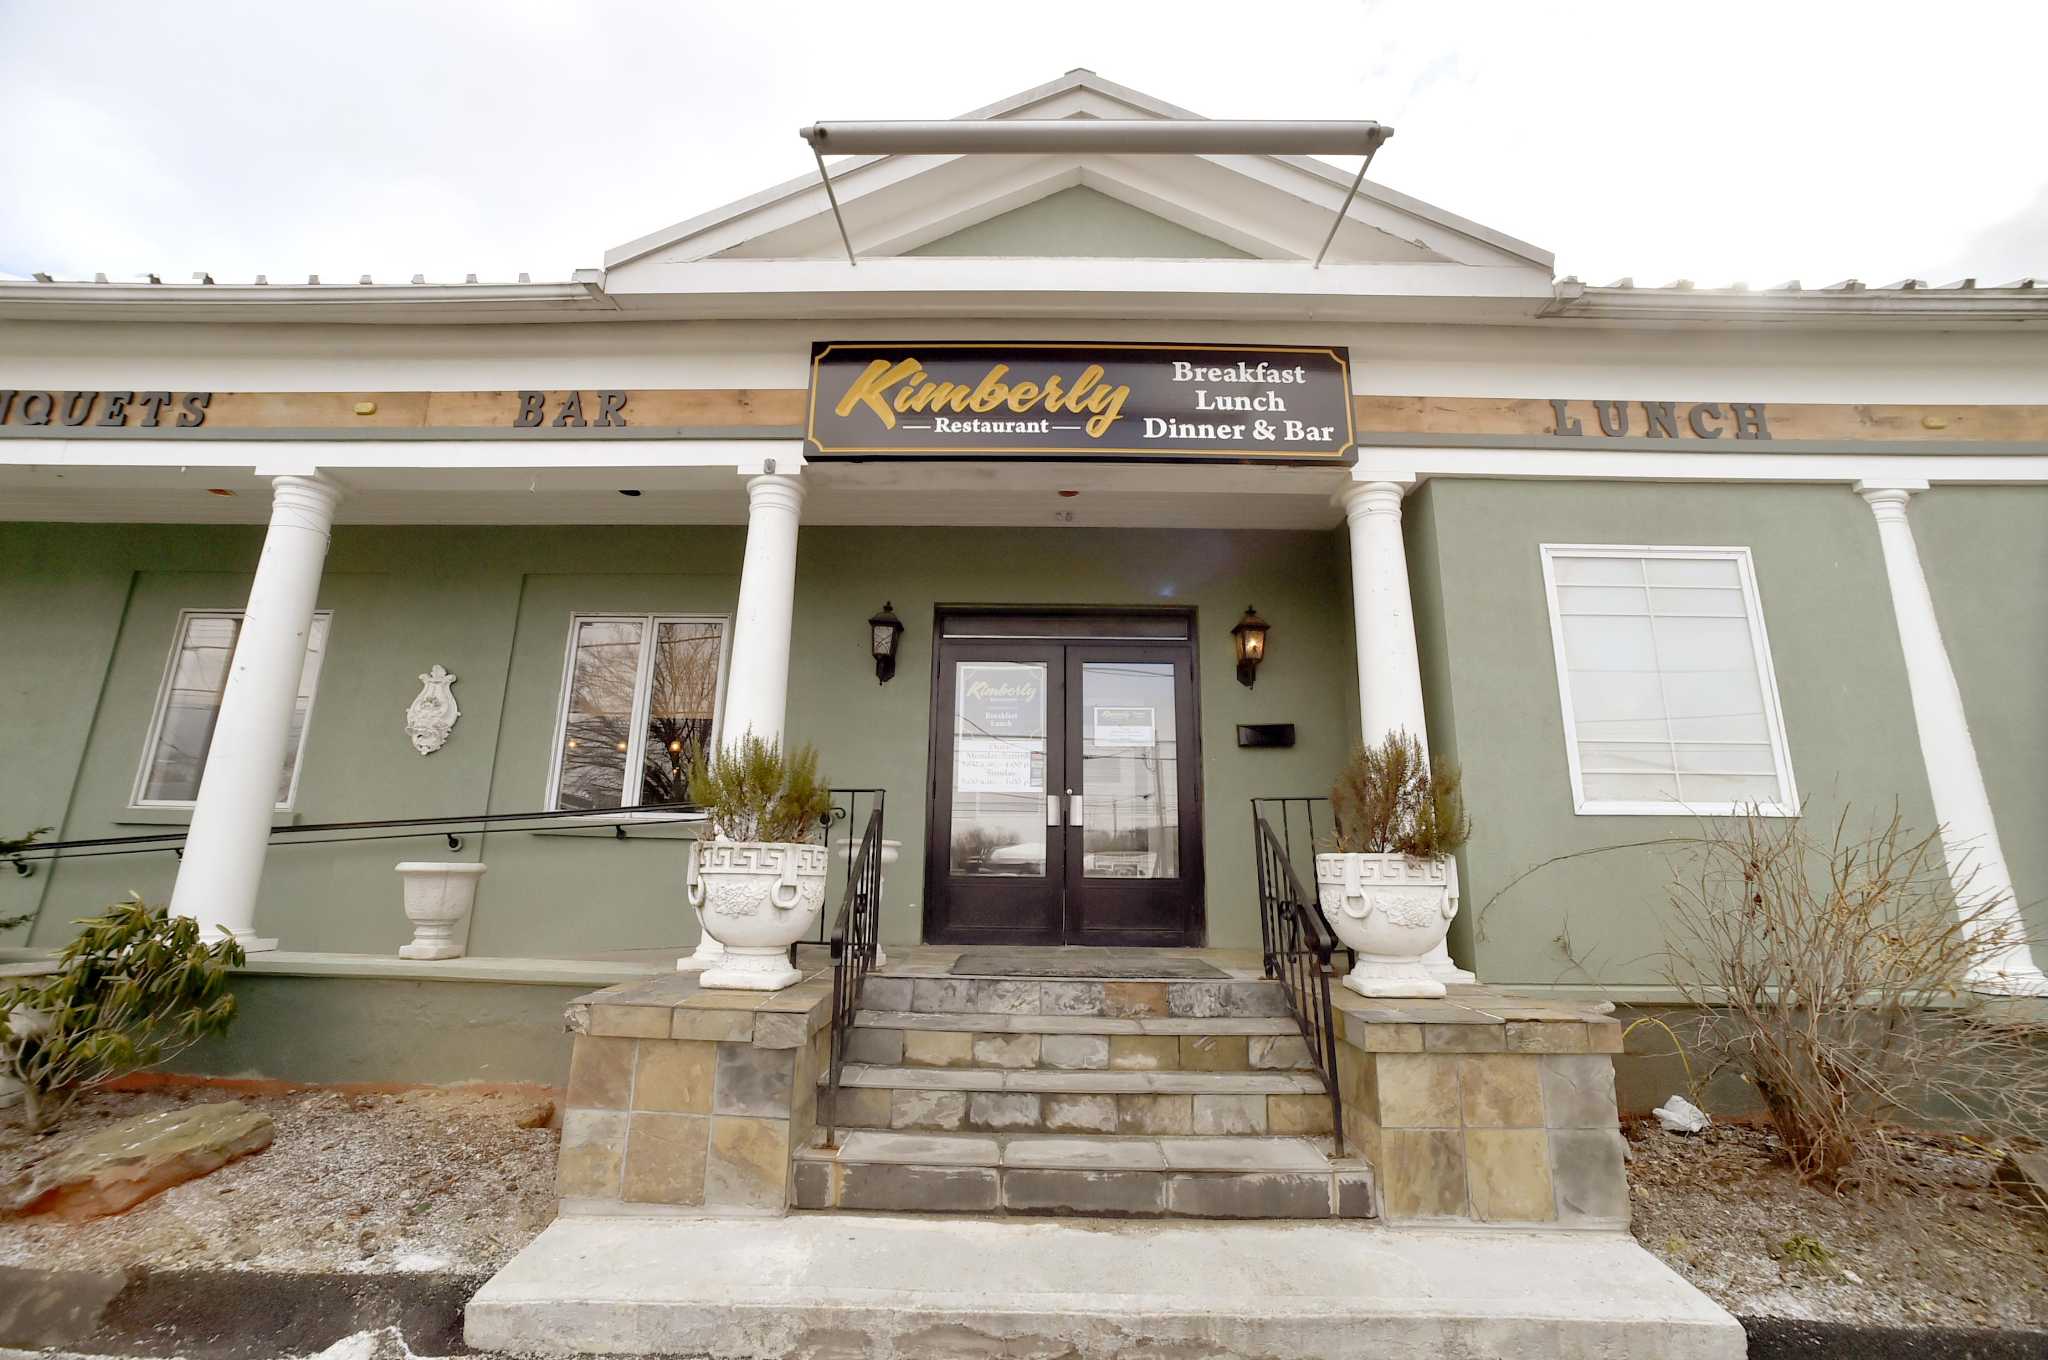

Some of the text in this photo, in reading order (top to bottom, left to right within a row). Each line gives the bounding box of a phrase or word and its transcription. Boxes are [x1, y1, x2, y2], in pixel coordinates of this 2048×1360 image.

[1172, 361, 1306, 384] Breakfast
[513, 390, 627, 427] BAR
[835, 357, 1131, 438] Kimberly
[1195, 390, 1286, 412] Lunch
[934, 417, 1049, 433] Restaurant
[1143, 417, 1334, 441] Dinner & Bar
[1550, 399, 1772, 440] LUNCH
